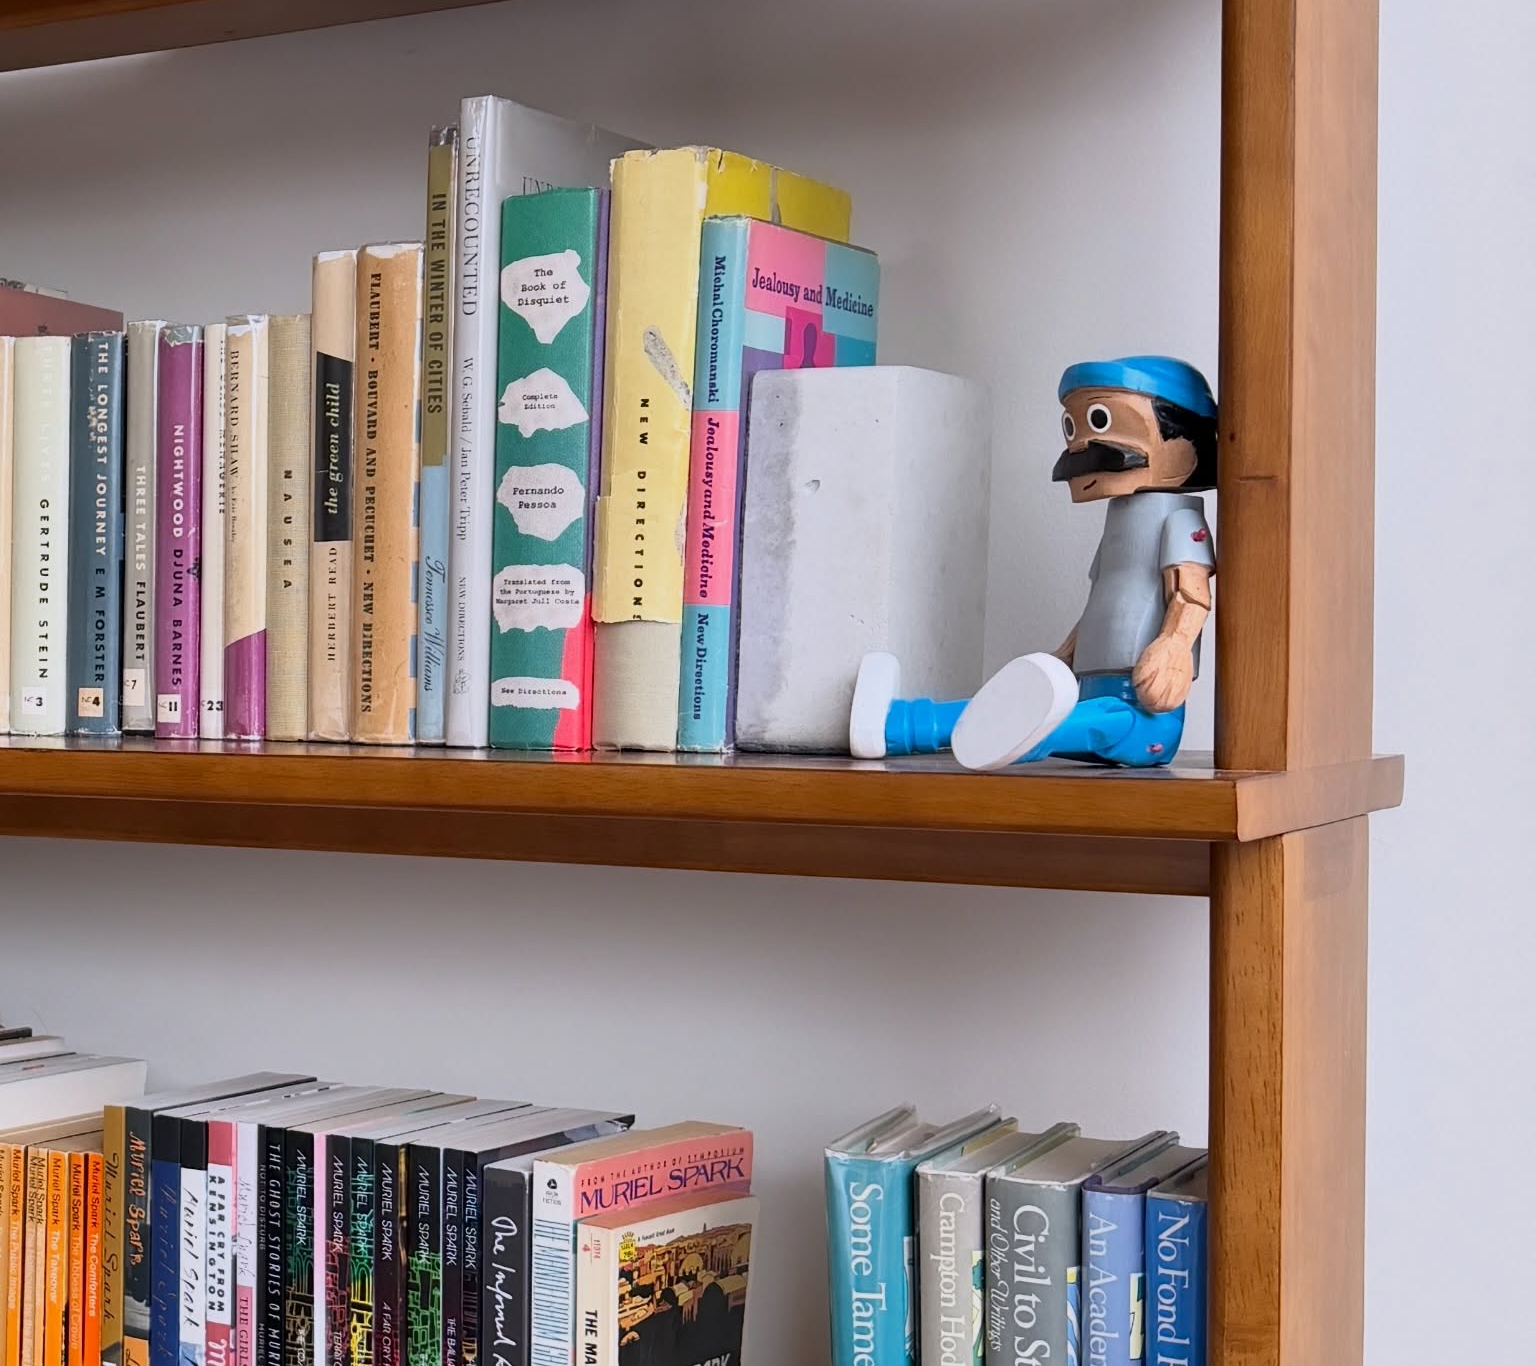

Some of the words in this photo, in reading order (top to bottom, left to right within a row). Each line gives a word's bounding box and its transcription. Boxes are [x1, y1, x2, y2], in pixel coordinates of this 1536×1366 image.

[432, 194, 446, 211] IN
[463, 137, 480, 315] UNRECOUNTED
[431, 219, 446, 250] THE
[368, 273, 380, 349] FLAUBERT
[430, 260, 444, 323] WINTER
[518, 296, 569, 305] Disquiet
[752, 267, 801, 300] Jealousy
[804, 286, 825, 304] and
[828, 293, 875, 317] Medicine
[98, 343, 108, 374] THE
[429, 332, 444, 354] OF
[366, 370, 379, 439] BOUVARD
[427, 360, 444, 413] CITIES
[96, 384, 108, 464] LONGEST
[135, 467, 146, 515] THREE
[172, 425, 184, 538] NIGHTWOOD
[365, 448, 377, 477] AND
[513, 487, 565, 496] Fernando
[95, 475, 106, 555] JOURNEY
[364, 486, 376, 562] PECUCHET
[518, 501, 557, 510] Pessoa
[39, 499, 49, 604] GERTRUDE
[135, 523, 146, 570] TALES
[172, 549, 183, 607] DJUNA
[363, 582, 374, 615] NEW
[38, 620, 48, 679] STEIN
[135, 581, 146, 661] FLAUBERT
[171, 619, 182, 686] BARNES
[361, 624, 373, 713] DIRECTIONS
[848, 1182, 882, 1275] Some
[930, 1193, 963, 1307] Crampton
[1013, 1205, 1049, 1286] Civil
[1157, 1213, 1188, 1261] No
[585, 1310, 597, 1338] THE
[1014, 1294, 1043, 1329] to
[1157, 1269, 1188, 1343] Fond
